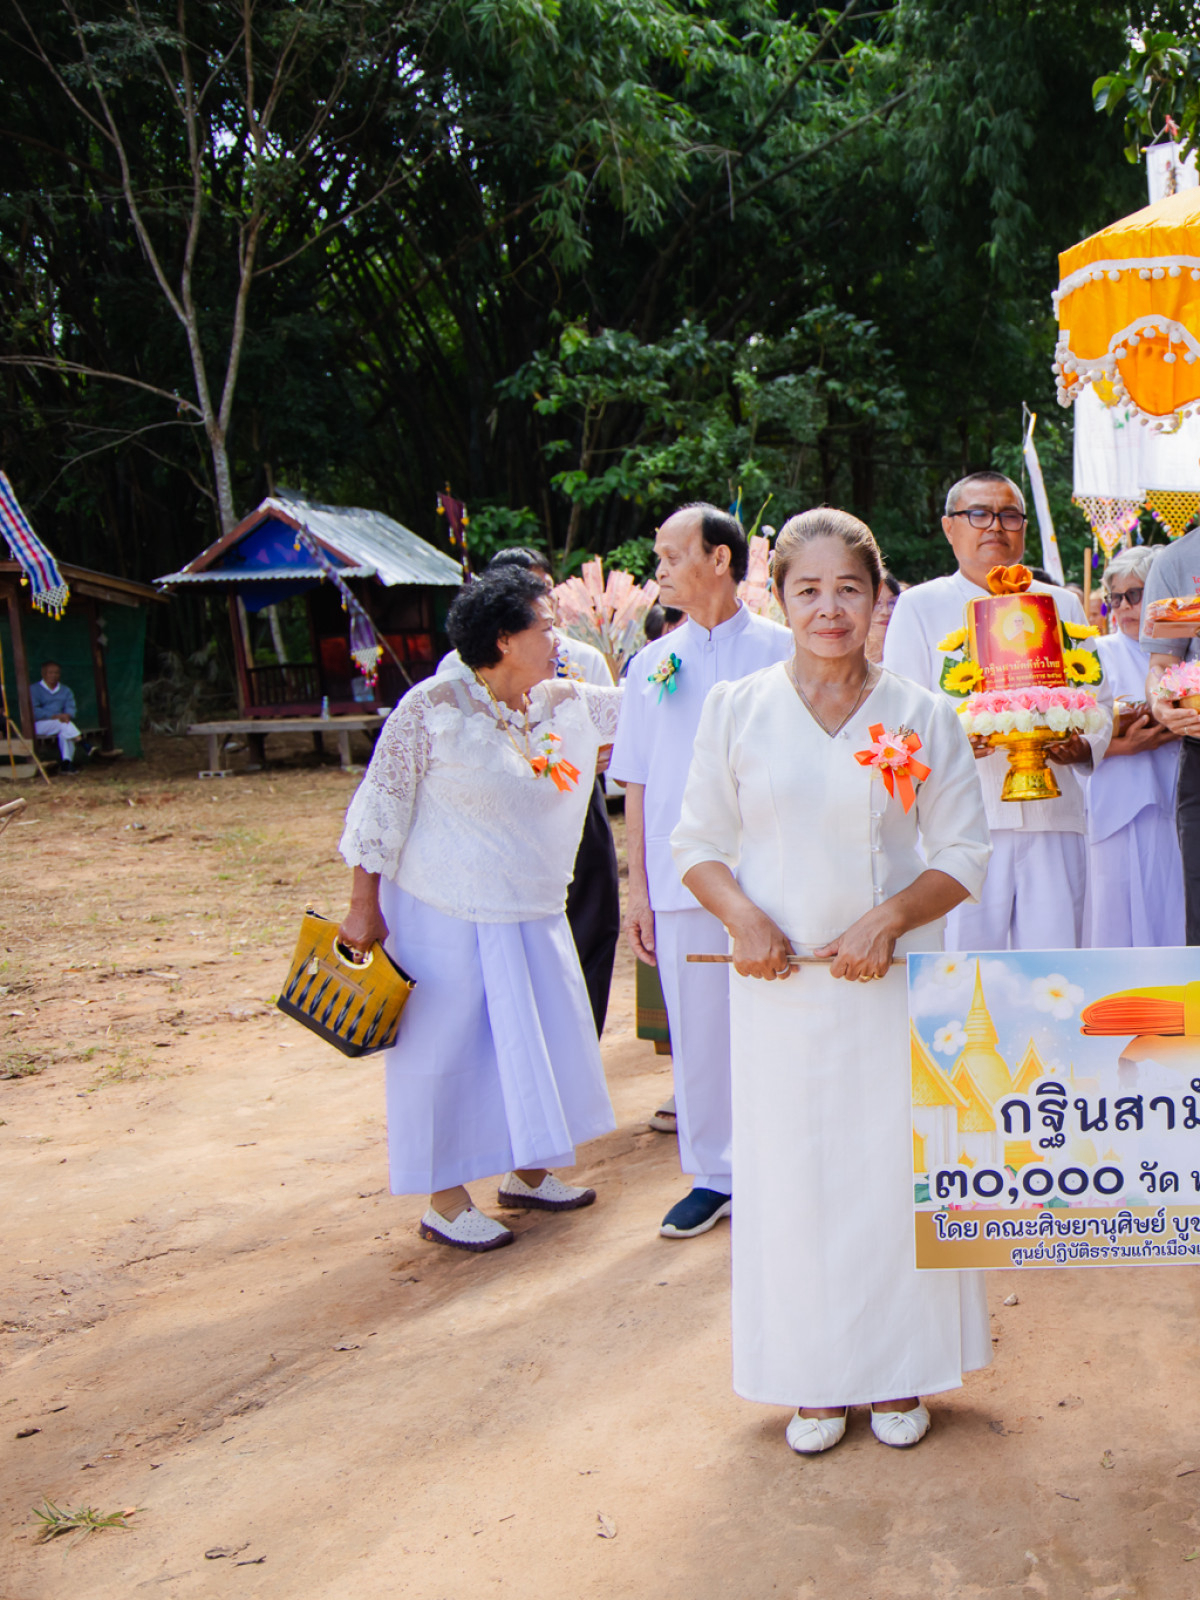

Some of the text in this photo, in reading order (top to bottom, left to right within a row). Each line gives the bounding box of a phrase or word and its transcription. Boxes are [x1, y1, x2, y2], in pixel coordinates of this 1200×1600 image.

[935, 1167, 1124, 1204] ๓๐,๐๐๐
[1139, 1161, 1179, 1193] วัด
[935, 1214, 977, 1239] โดย
[986, 1208, 1166, 1243] คณะศิษยานุศิษย์
